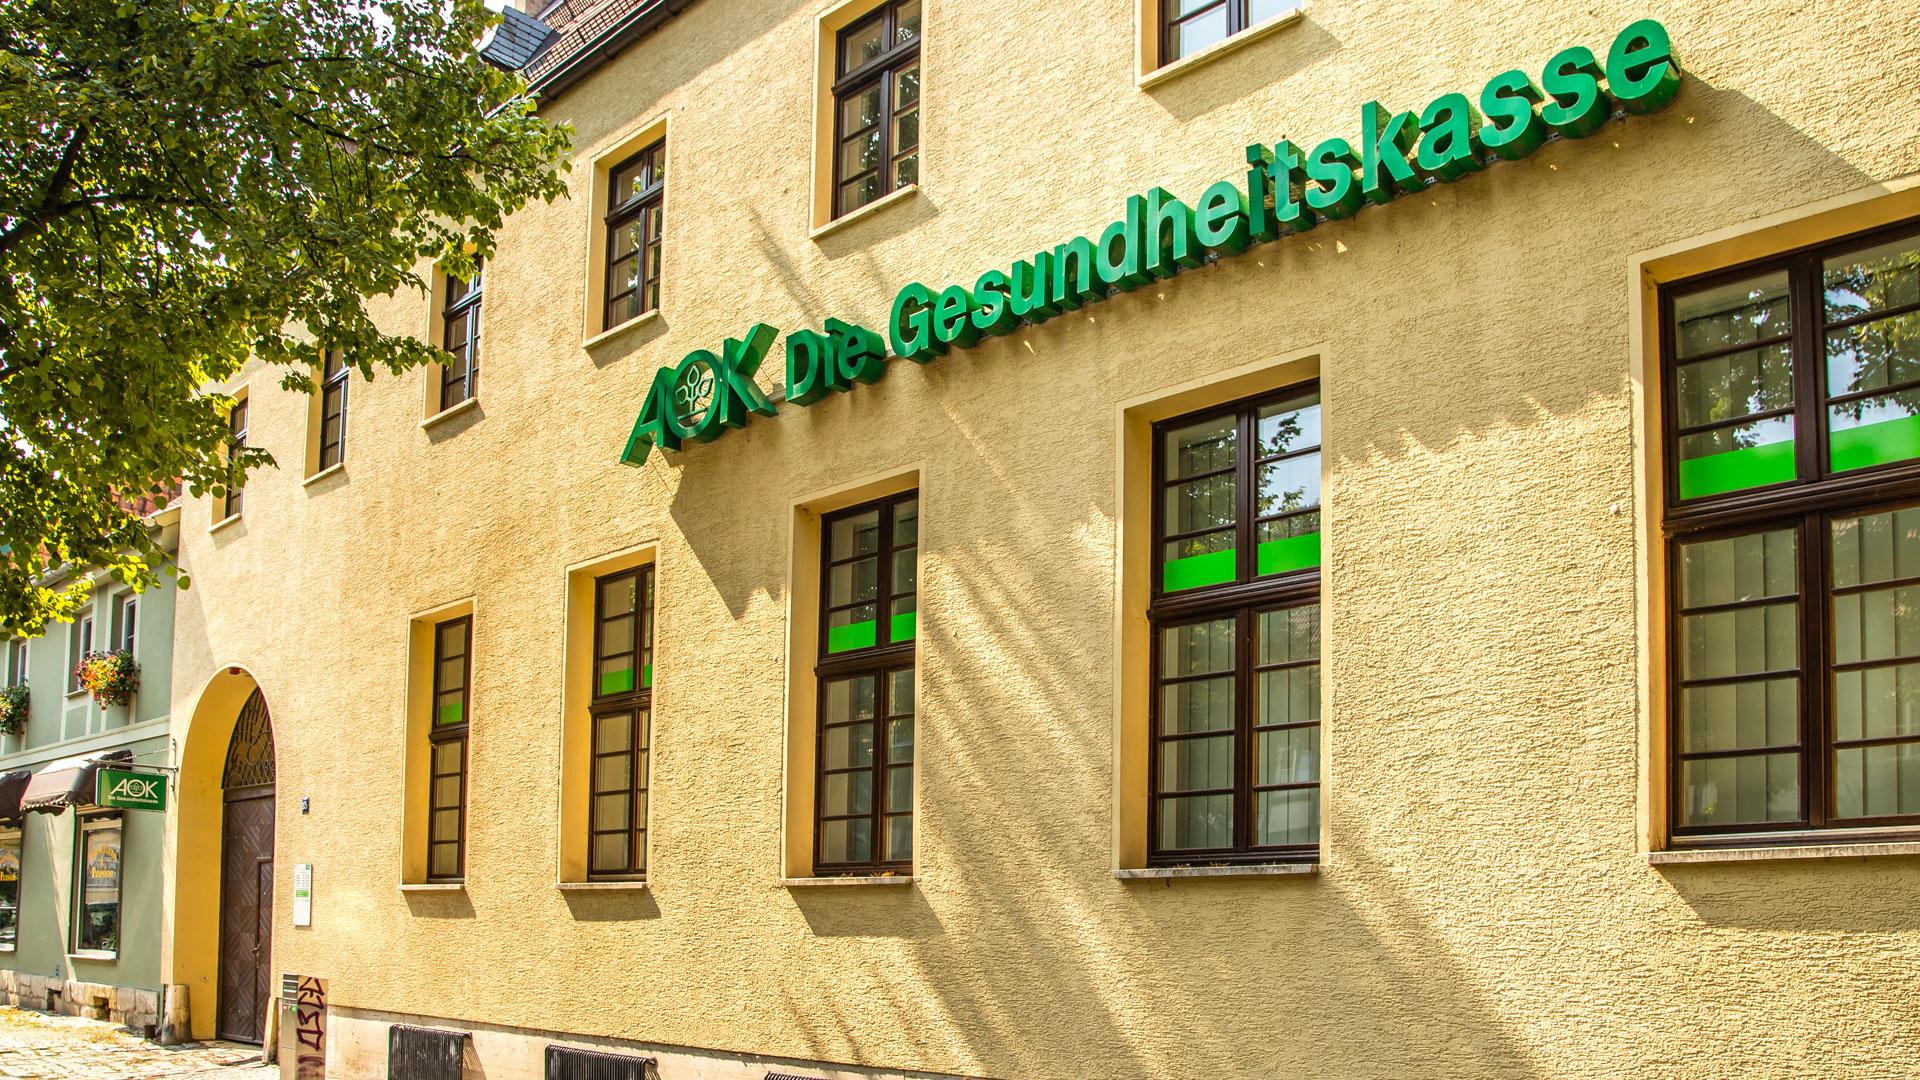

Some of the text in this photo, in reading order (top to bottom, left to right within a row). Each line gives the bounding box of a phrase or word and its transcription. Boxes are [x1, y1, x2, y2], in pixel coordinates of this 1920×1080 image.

[619, 18, 1682, 468] AOK Die Gesundheitskasse
[110, 778, 159, 799] AOK
